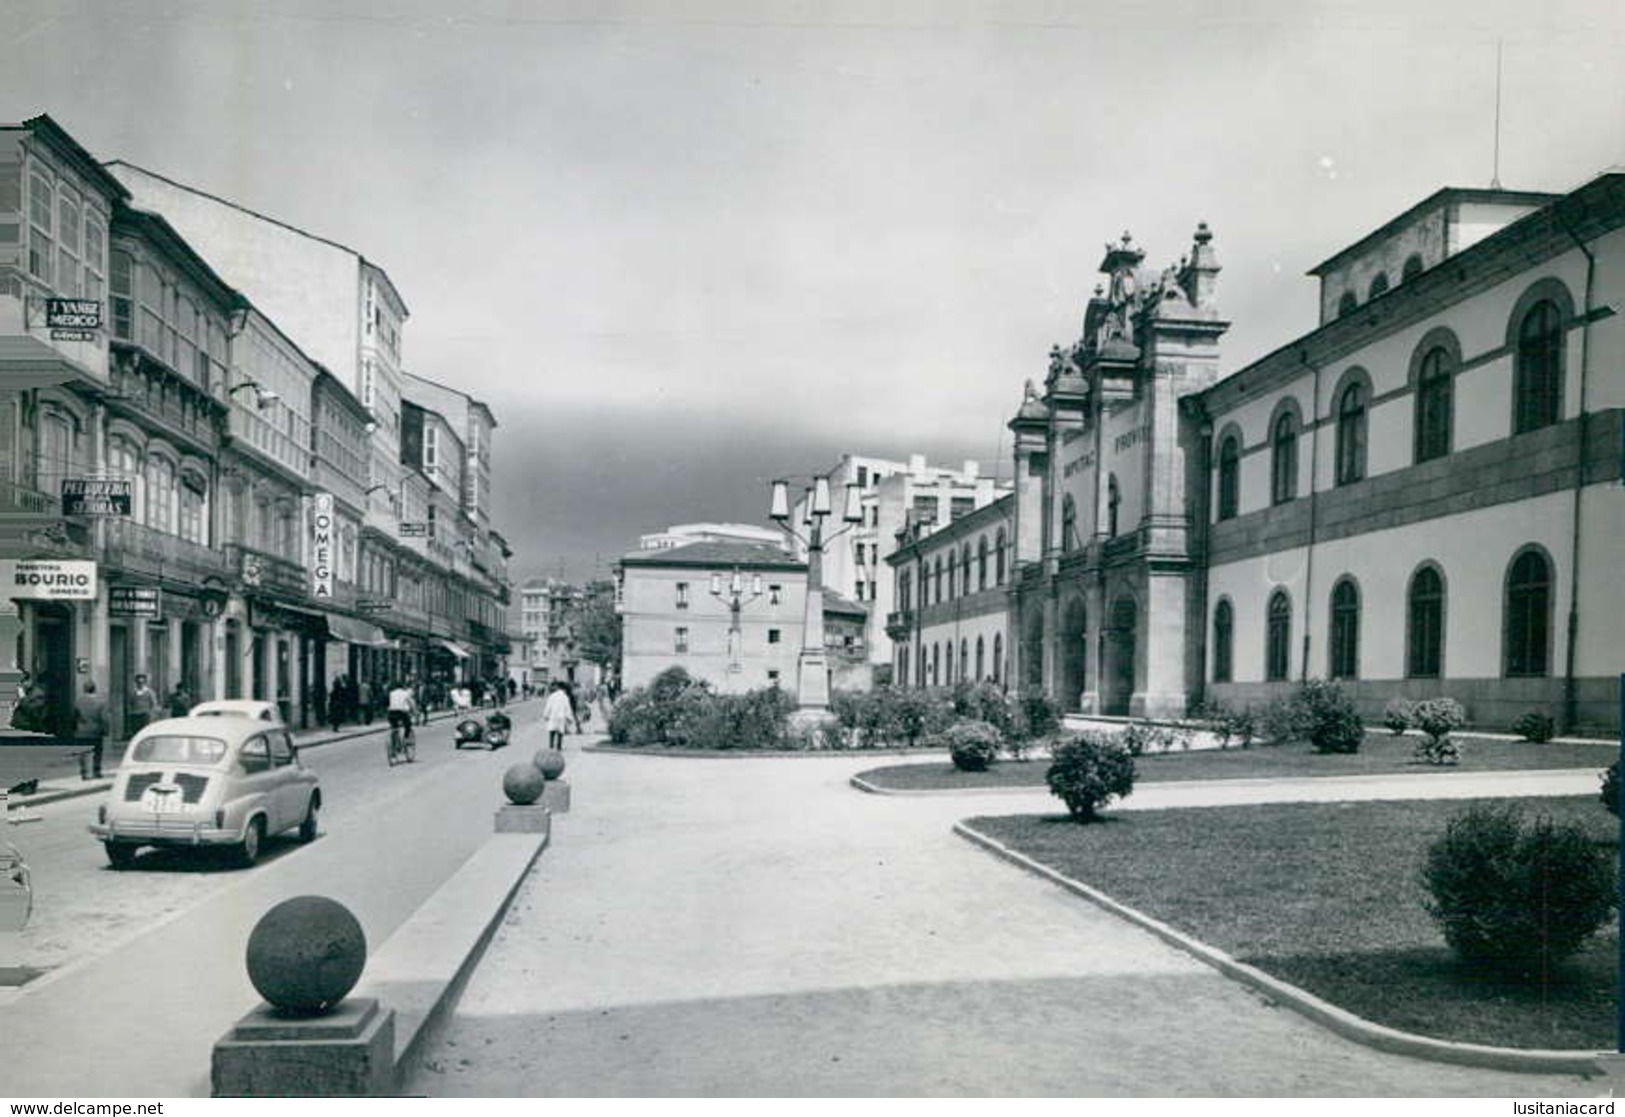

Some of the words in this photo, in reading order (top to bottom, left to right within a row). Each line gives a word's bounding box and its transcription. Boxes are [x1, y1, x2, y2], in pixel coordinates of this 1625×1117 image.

[50, 314, 98, 327] MEDICO
[315, 515, 331, 596] OMEGA
[14, 573, 89, 587] BOURIO
